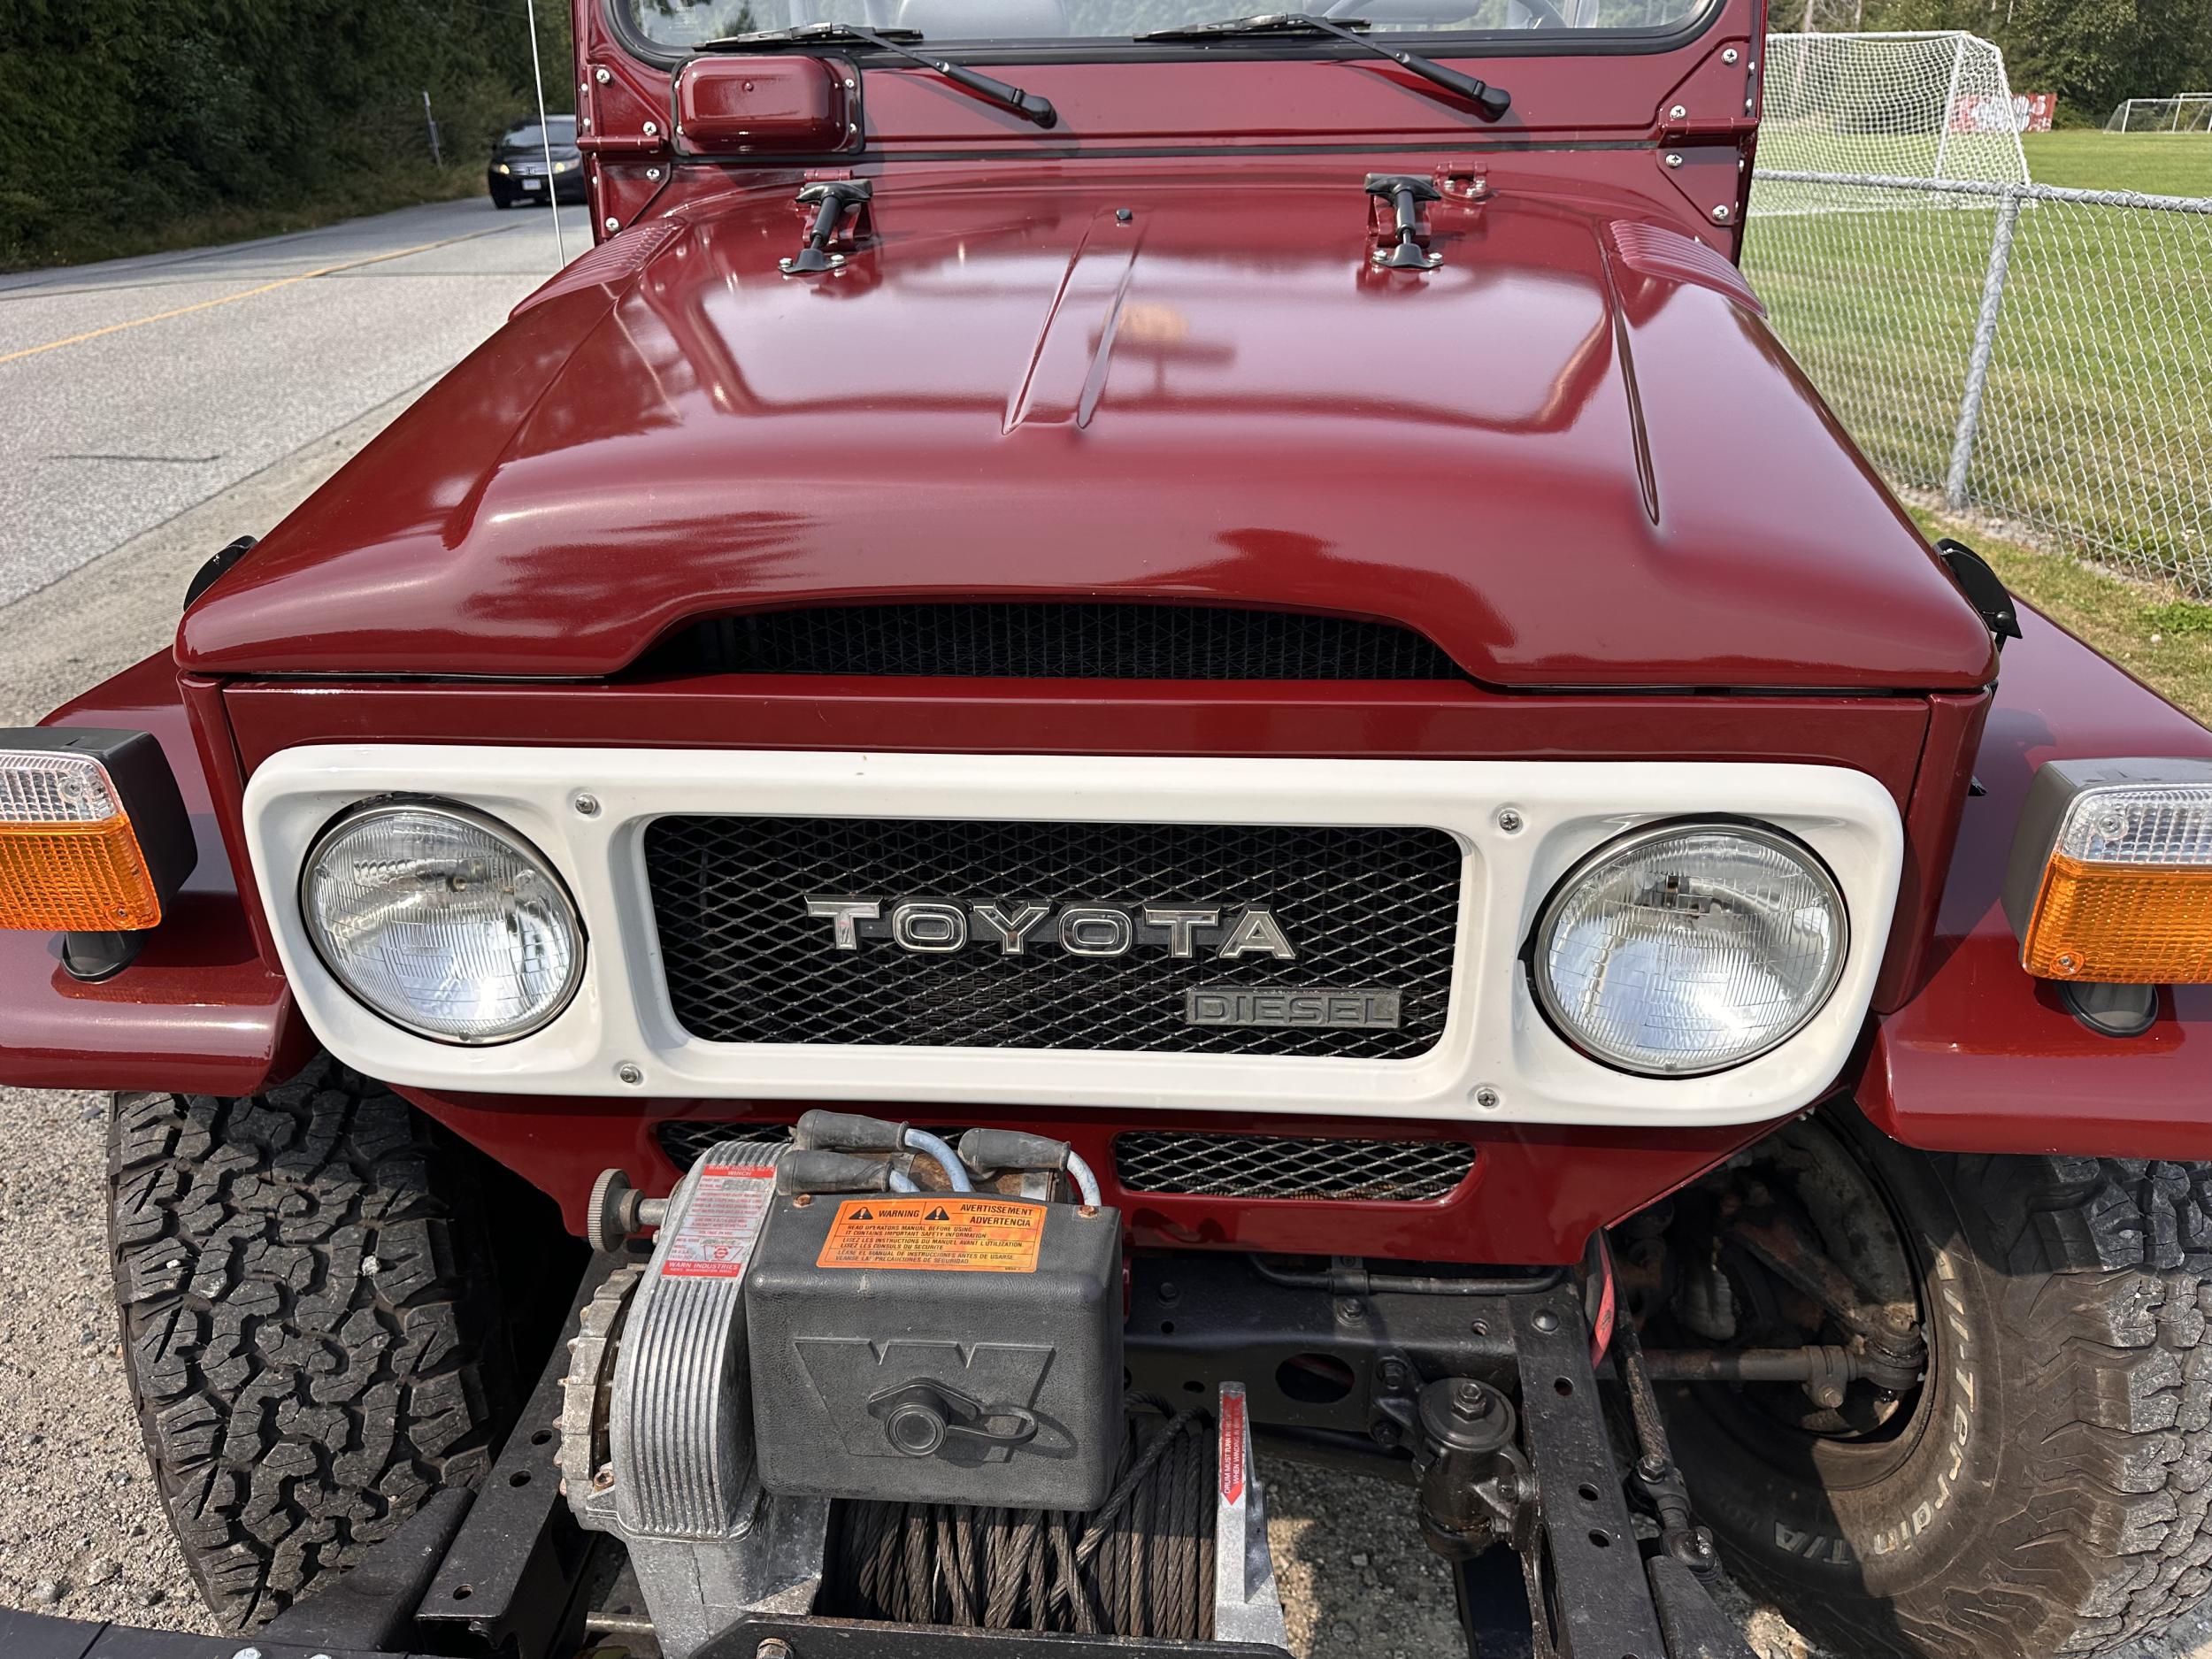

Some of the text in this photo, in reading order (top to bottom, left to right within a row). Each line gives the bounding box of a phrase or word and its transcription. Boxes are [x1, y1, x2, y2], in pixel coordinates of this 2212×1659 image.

[804, 895, 1297, 960] TOYOTA
[1194, 995, 1395, 1026] DIESEL
[960, 1203, 1033, 1216] AVERTISSEMENT
[970, 1216, 1031, 1227] ADVERTENCIA
